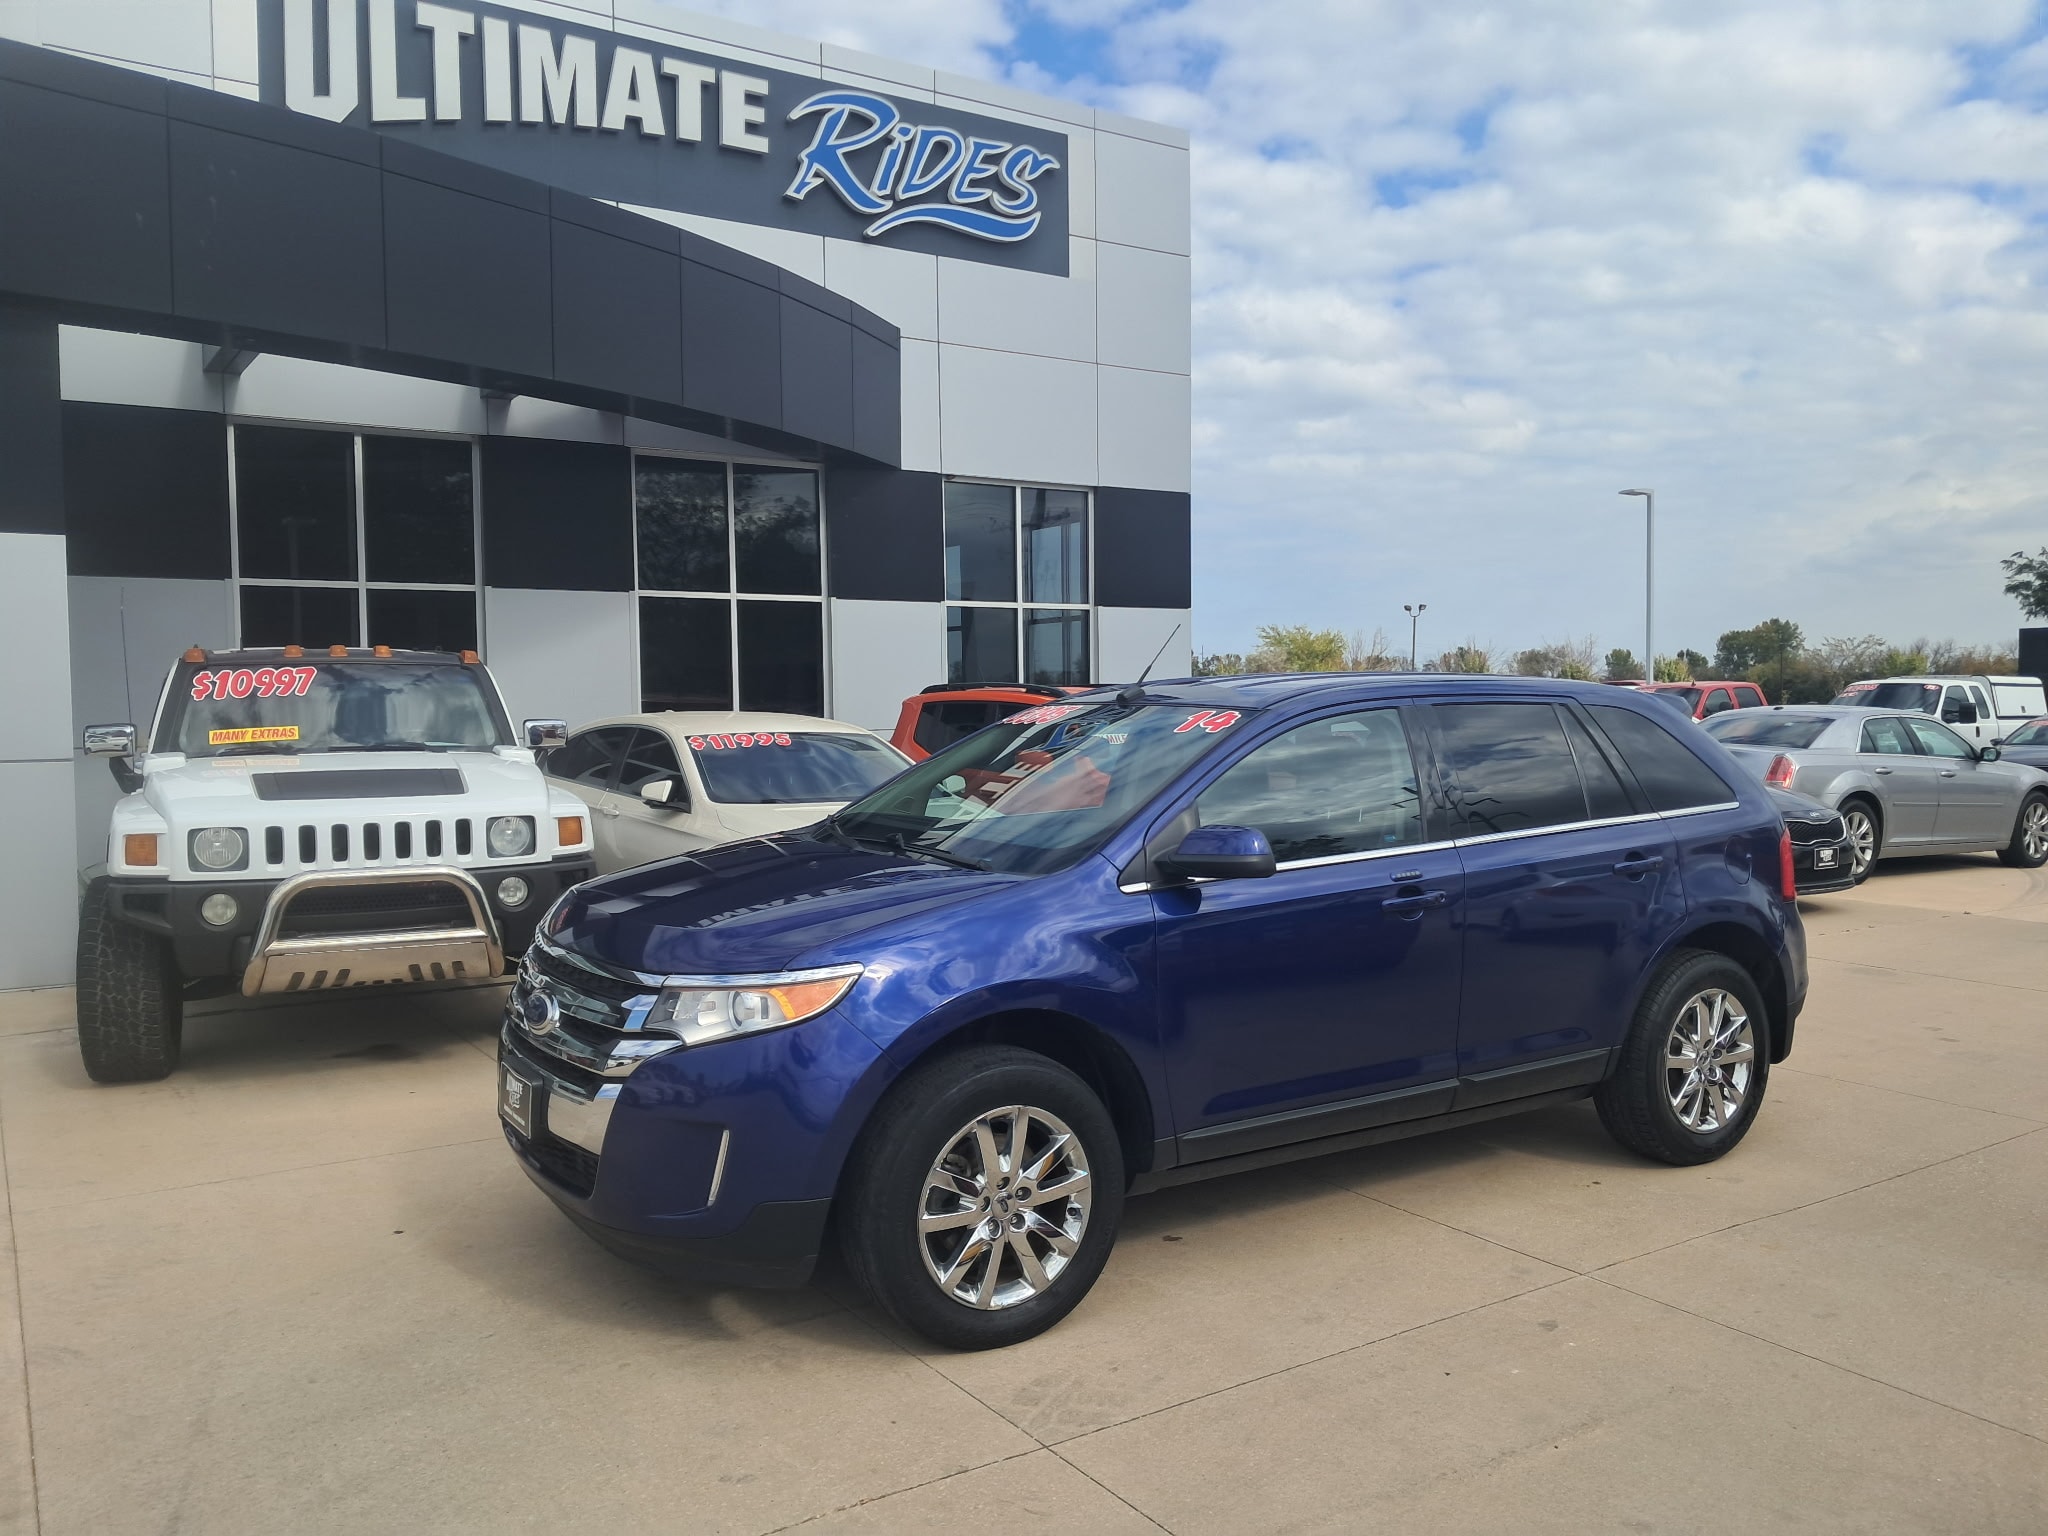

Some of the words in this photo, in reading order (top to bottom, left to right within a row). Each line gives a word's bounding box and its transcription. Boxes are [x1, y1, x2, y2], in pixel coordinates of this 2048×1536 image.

[284, 0, 769, 154] ULTIMATE
[191, 667, 317, 700] $10997
[1173, 709, 1242, 734] 14
[212, 730, 248, 743] MANY
[251, 727, 296, 740] EXTRAS
[688, 733, 792, 751] $11995
